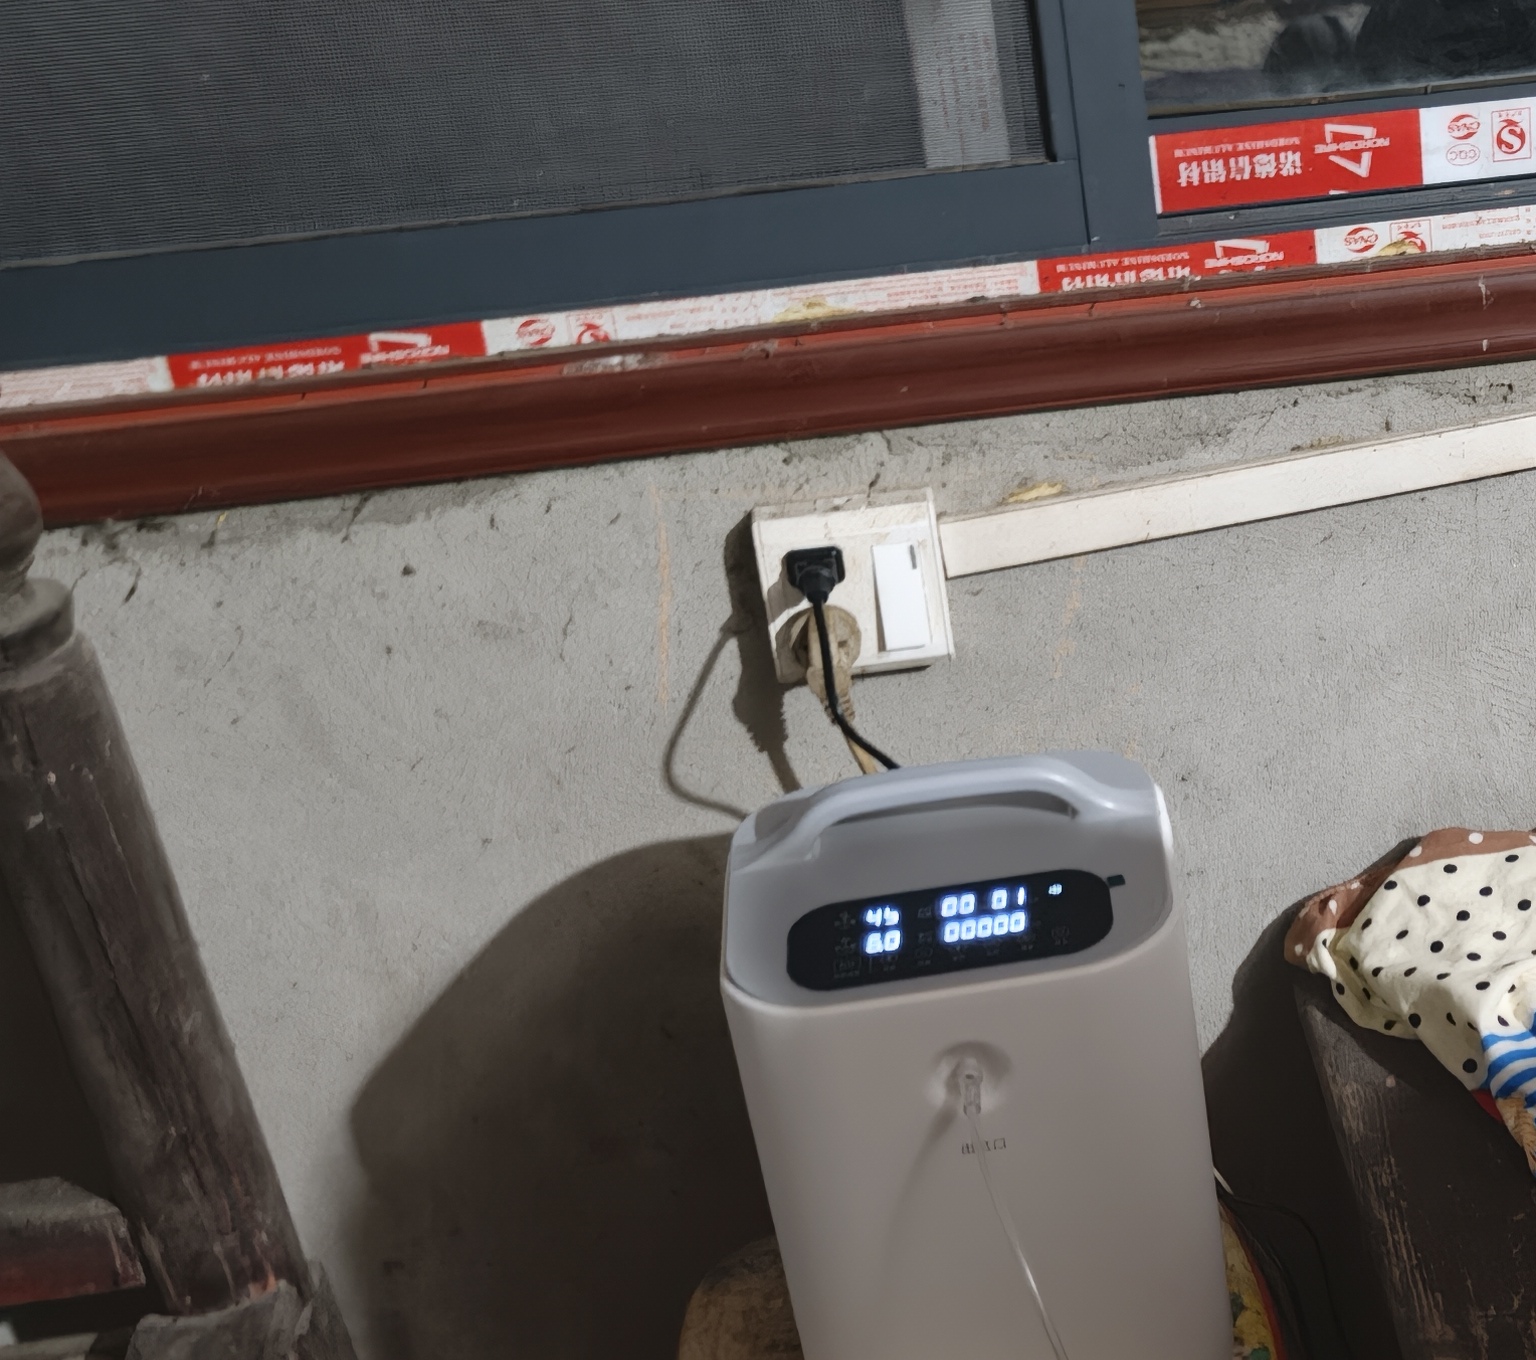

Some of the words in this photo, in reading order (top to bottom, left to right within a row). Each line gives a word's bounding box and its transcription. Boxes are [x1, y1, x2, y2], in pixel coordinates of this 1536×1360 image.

[1176, 149, 1303, 188] 诺德信铝材
